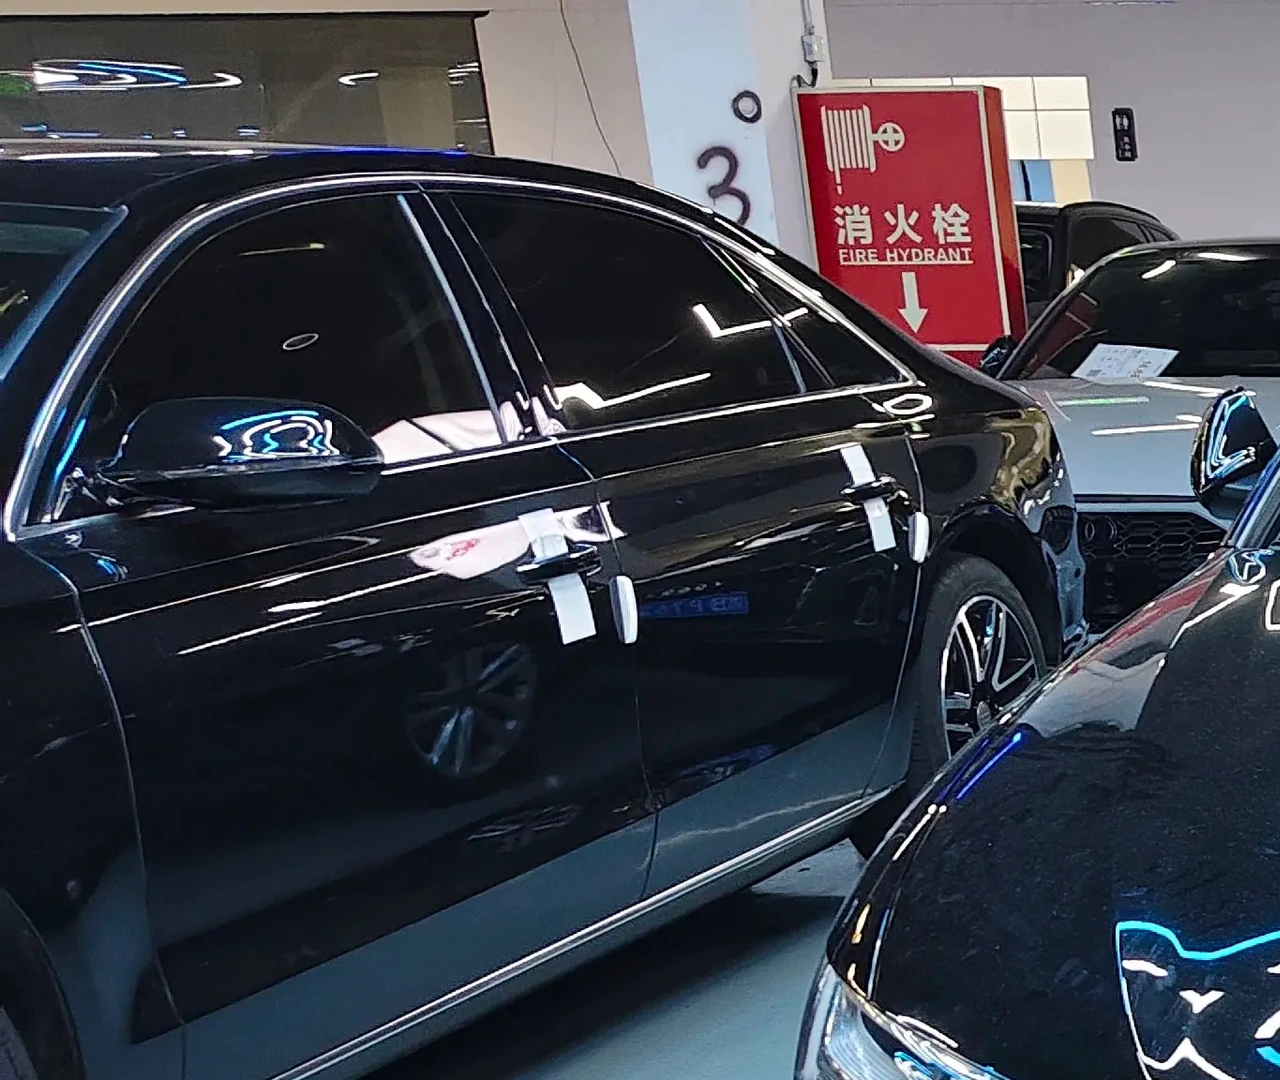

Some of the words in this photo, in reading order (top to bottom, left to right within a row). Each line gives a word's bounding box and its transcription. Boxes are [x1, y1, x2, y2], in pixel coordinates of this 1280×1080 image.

[834, 203, 972, 245] 消火栓
[838, 249, 878, 263] FIRE
[886, 247, 973, 262] HYDRANT
